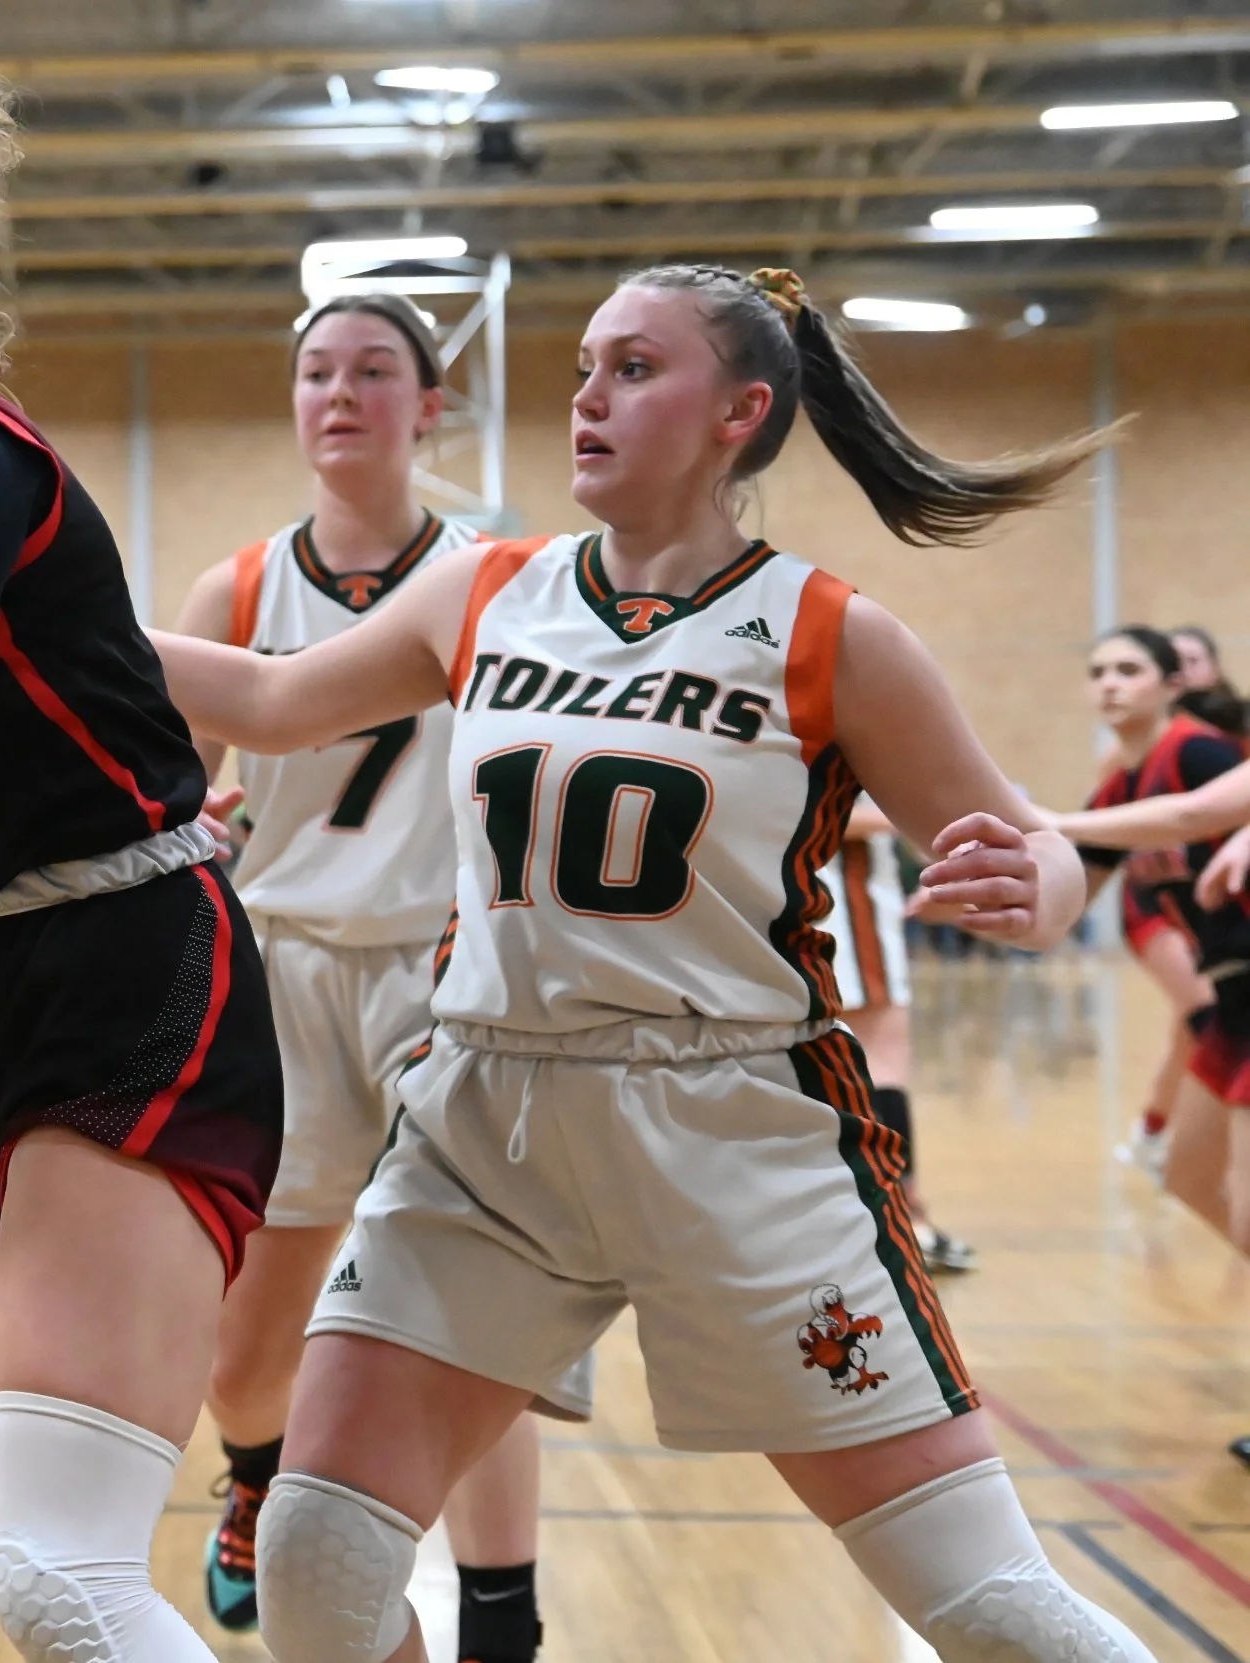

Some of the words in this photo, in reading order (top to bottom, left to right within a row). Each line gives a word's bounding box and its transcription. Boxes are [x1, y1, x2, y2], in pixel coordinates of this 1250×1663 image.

[337, 575, 382, 606] T
[617, 598, 673, 633] T
[724, 628, 780, 649] adidas
[463, 653, 774, 744] TOILERS
[314, 712, 424, 835] 7
[472, 742, 715, 921] 10
